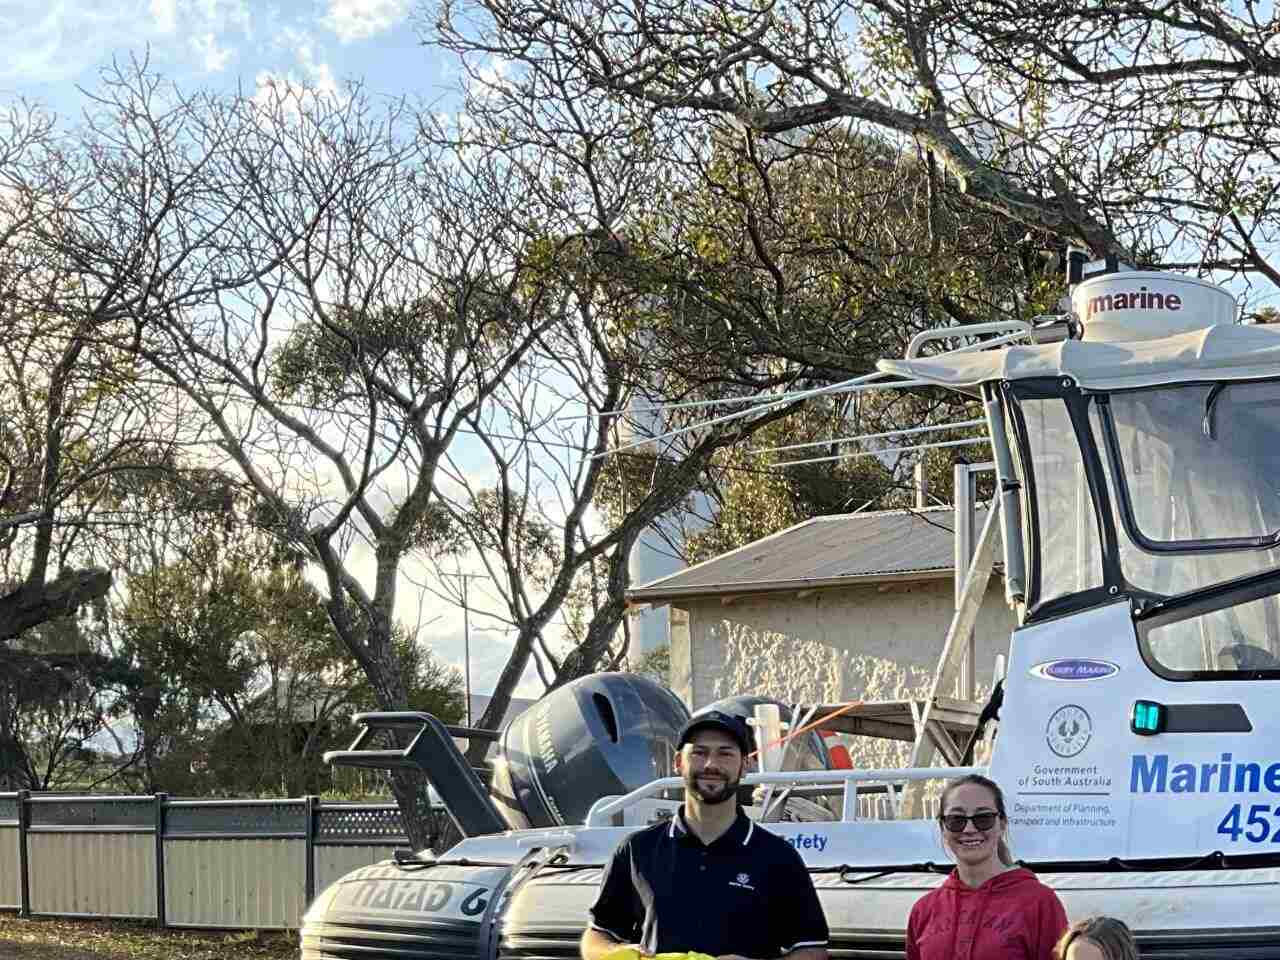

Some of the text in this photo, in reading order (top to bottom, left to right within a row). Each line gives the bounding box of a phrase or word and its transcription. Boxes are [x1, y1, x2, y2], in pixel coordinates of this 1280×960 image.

[1034, 765, 1098, 775] Government
[1018, 776, 1112, 787] of South Australia
[789, 833, 828, 852] afety
[460, 887, 489, 917] 6
